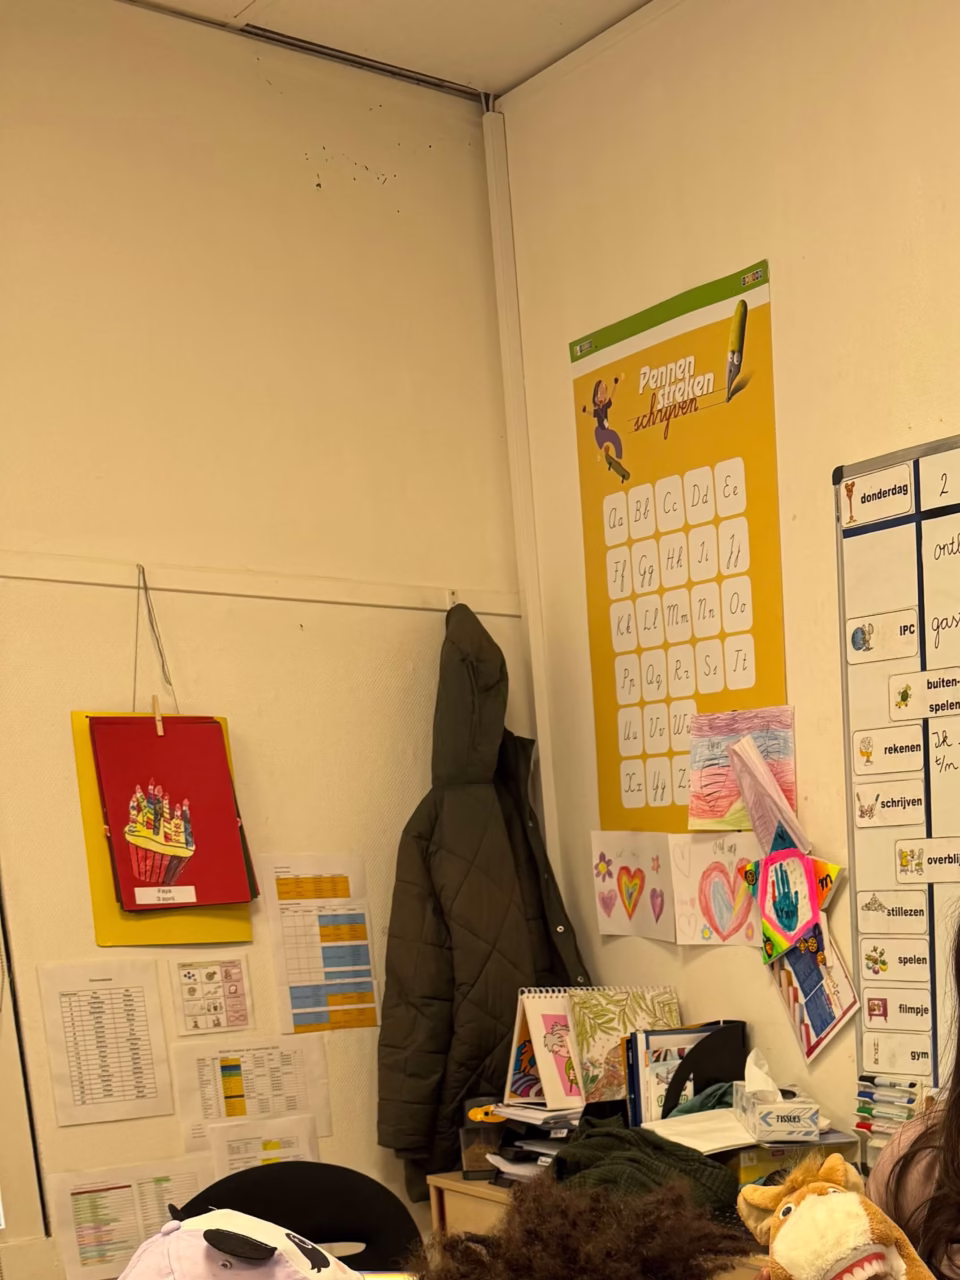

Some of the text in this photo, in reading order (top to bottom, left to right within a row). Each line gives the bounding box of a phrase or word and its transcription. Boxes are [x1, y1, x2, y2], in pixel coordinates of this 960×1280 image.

[639, 355, 695, 394] Pennen
[657, 373, 714, 410] streken
[634, 392, 699, 440] schrijven
[939, 473, 949, 497] 2
[860, 482, 908, 504] donderdag
[899, 624, 915, 636] IPC
[927, 677, 960, 690] buiten-
[929, 700, 960, 714] spelen
[932, 730, 953, 748] Ik
[884, 743, 922, 755] rekenen
[935, 755, 959, 773] t/m
[881, 797, 923, 810] schrijven
[887, 906, 925, 917] stillezen
[898, 955, 927, 966] spelen
[899, 1003, 929, 1017] filmpje
[910, 1050, 929, 1061] gym
[776, 1114, 801, 1123] TISSUES
